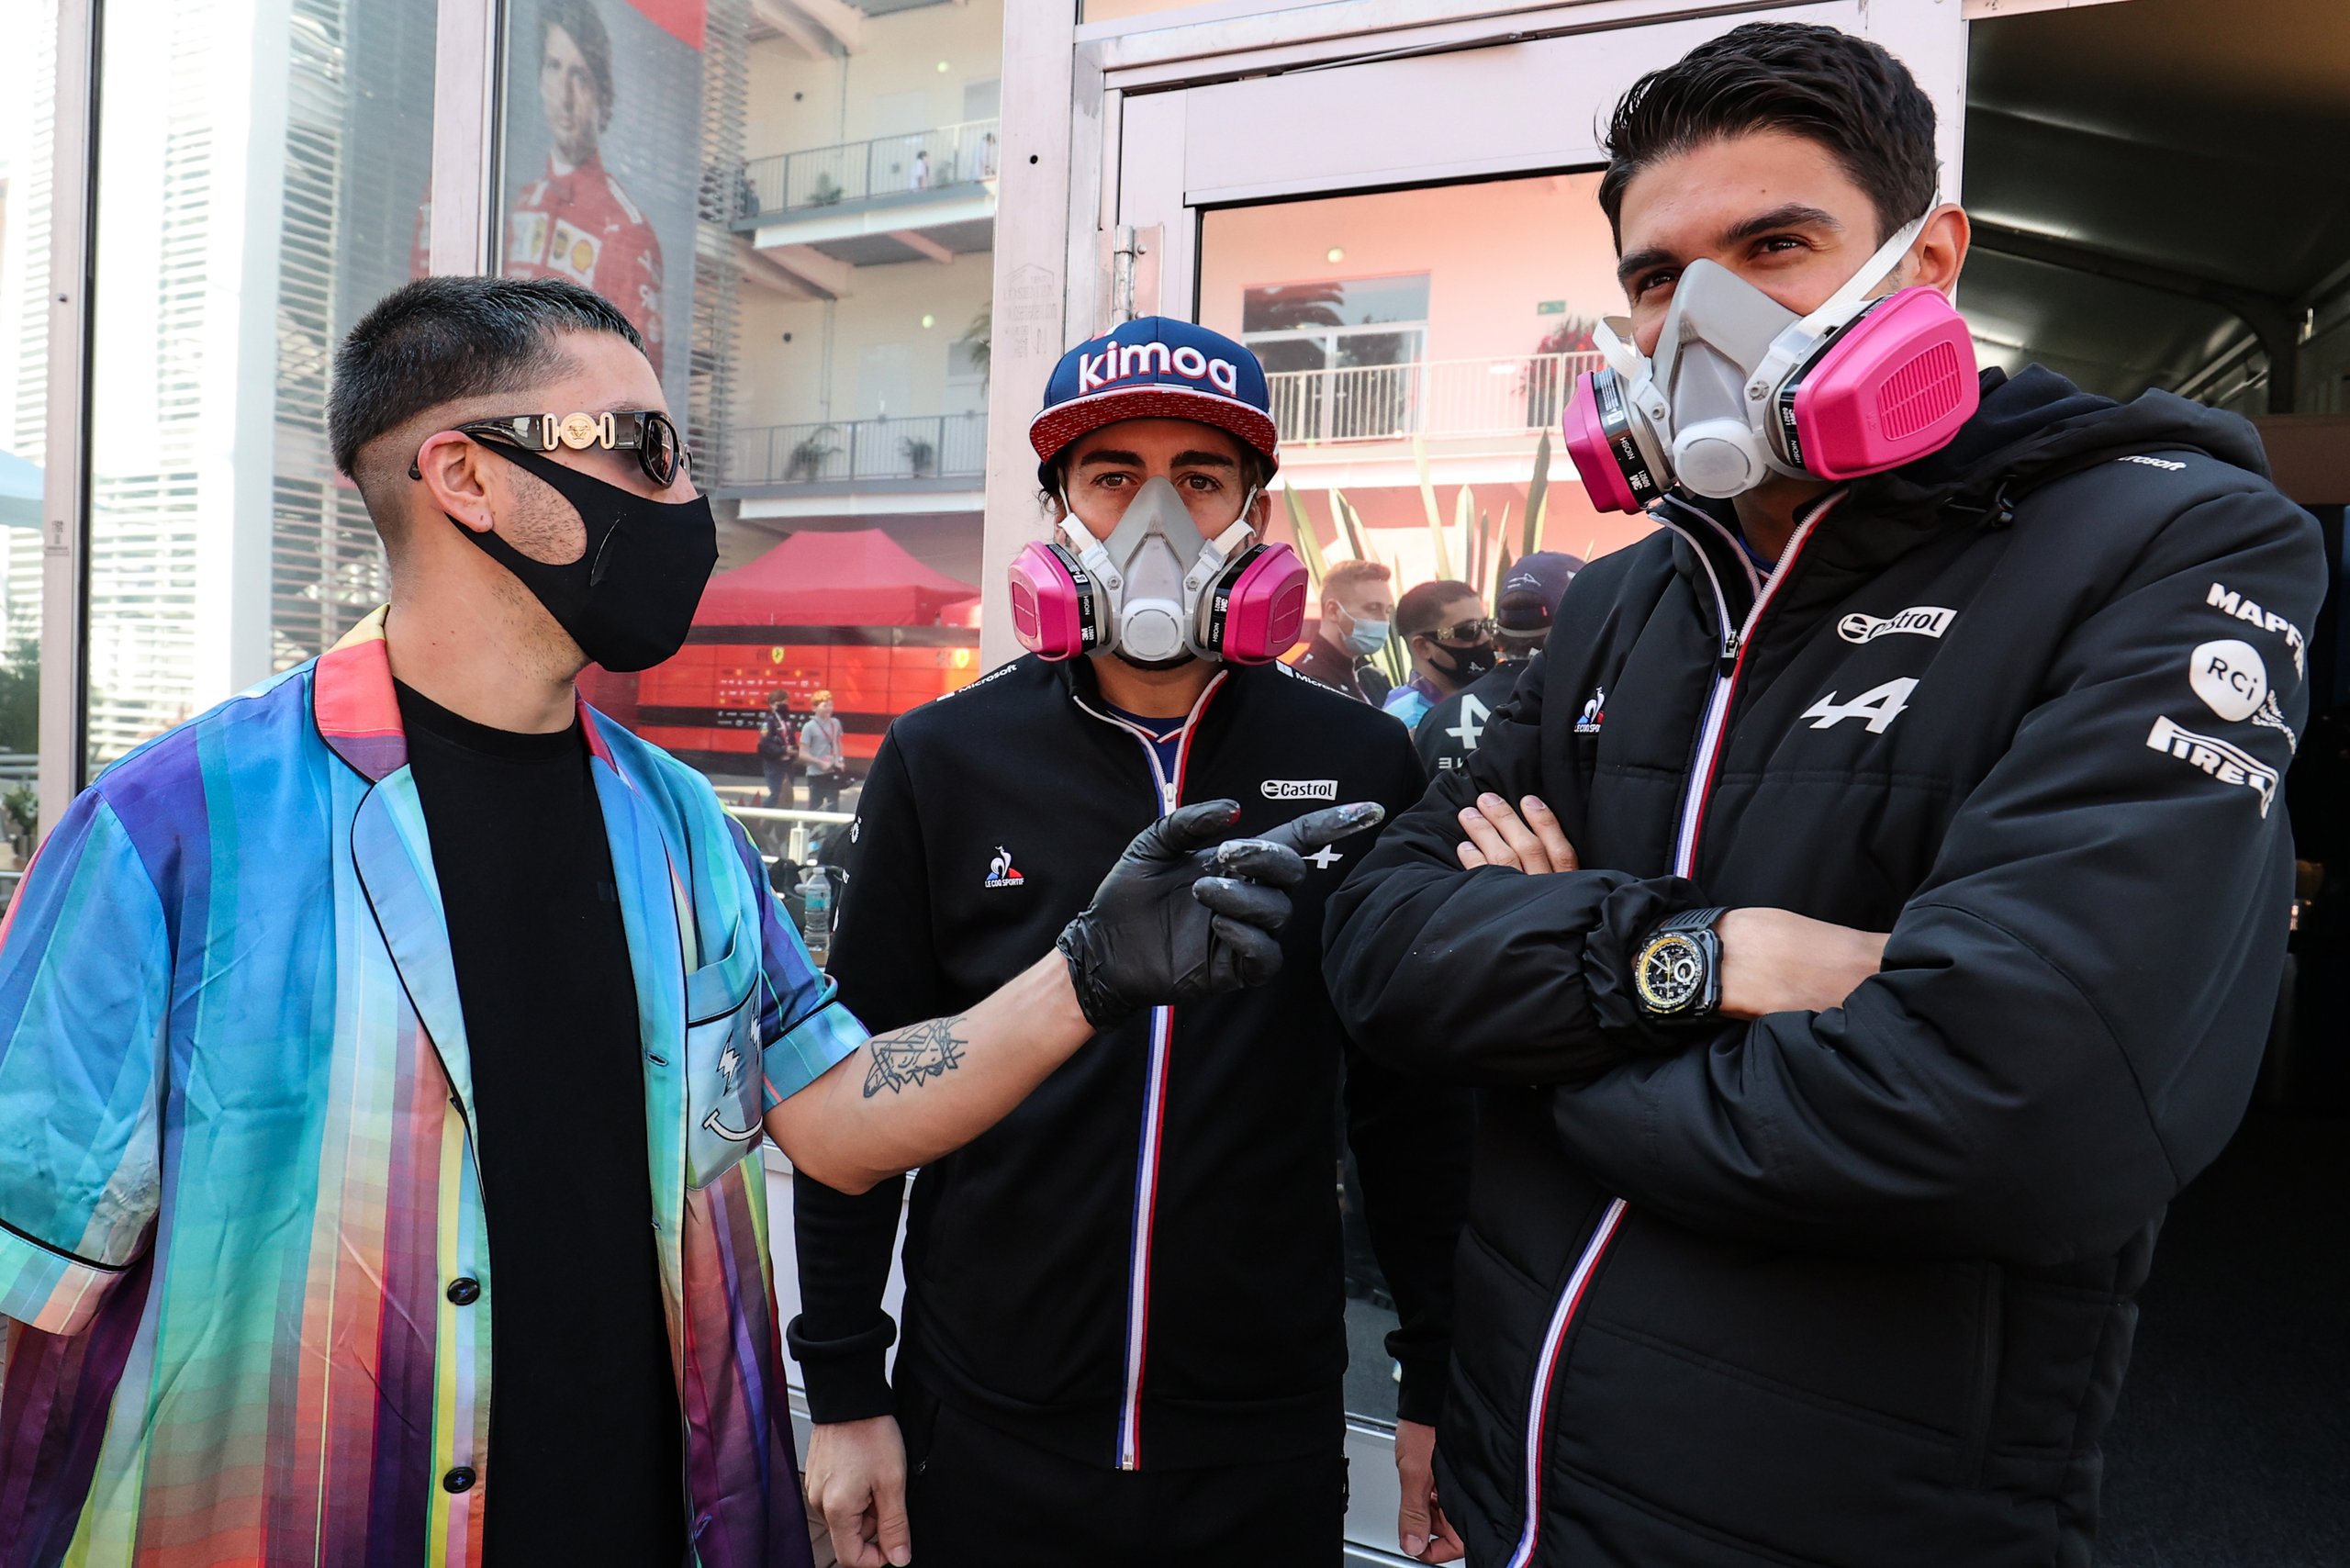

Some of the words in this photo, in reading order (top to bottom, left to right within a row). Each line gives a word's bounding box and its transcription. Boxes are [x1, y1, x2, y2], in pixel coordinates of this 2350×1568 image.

[1079, 341, 1237, 396] kimoa
[1619, 436, 1635, 461] NIOSH
[1790, 440, 1801, 464] NIOSH
[2115, 455, 2187, 471] rosoft
[1628, 474, 1643, 491] 3M
[1220, 598, 1228, 612] 3M
[1081, 627, 1089, 641] 3M
[1212, 622, 1220, 643] NIOSH
[1867, 610, 1944, 640] Cstrol
[2206, 582, 2304, 680] MAPFR
[958, 664, 1017, 693] Microsoft
[1294, 672, 1353, 698] Micro
[2145, 714, 2279, 819] PIREL
[1281, 783, 1333, 797] Castrol
